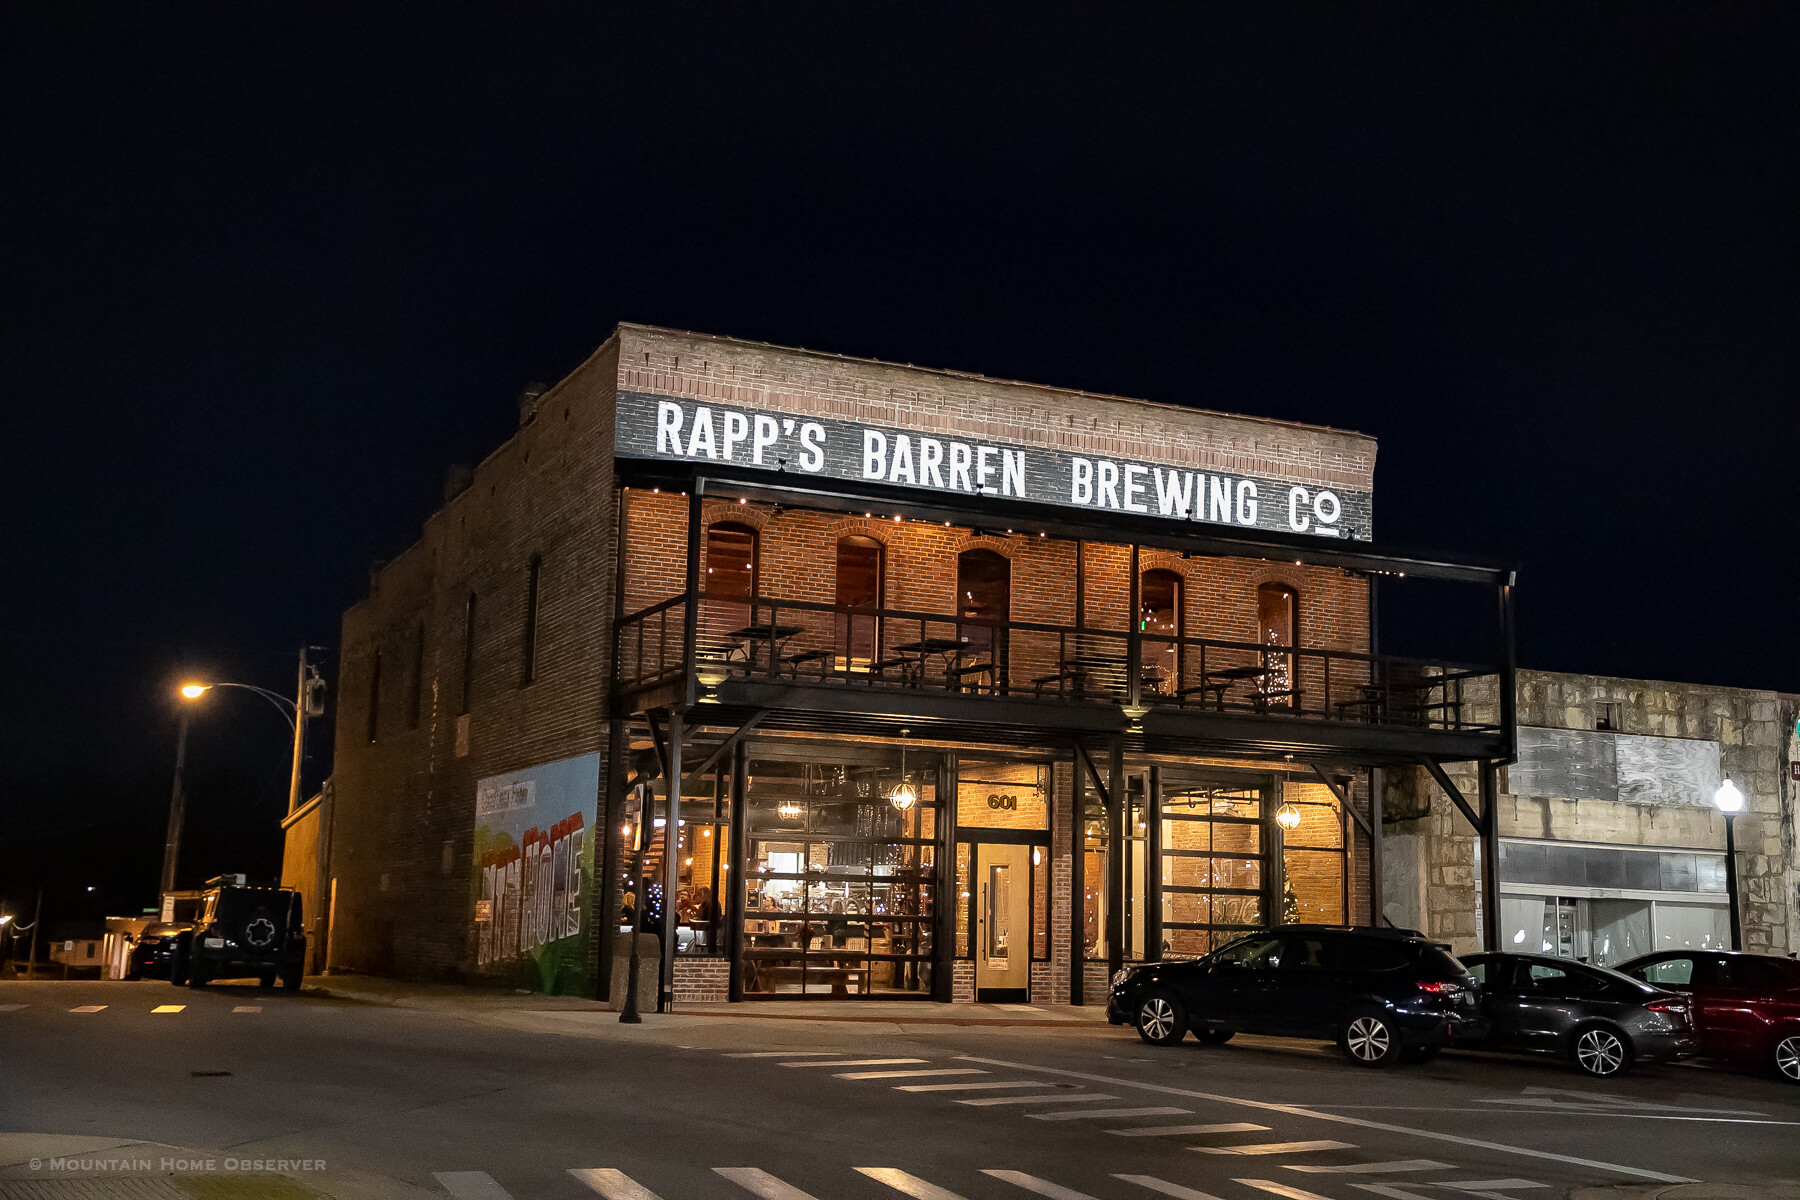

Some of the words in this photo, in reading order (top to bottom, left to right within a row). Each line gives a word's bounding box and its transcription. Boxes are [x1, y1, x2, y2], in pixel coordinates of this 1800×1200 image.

[656, 400, 826, 472] RAPP'S
[863, 429, 1026, 497] BARREN
[1071, 456, 1258, 526] BREWING
[987, 794, 1017, 810] 601
[520, 827, 585, 953] HOME
